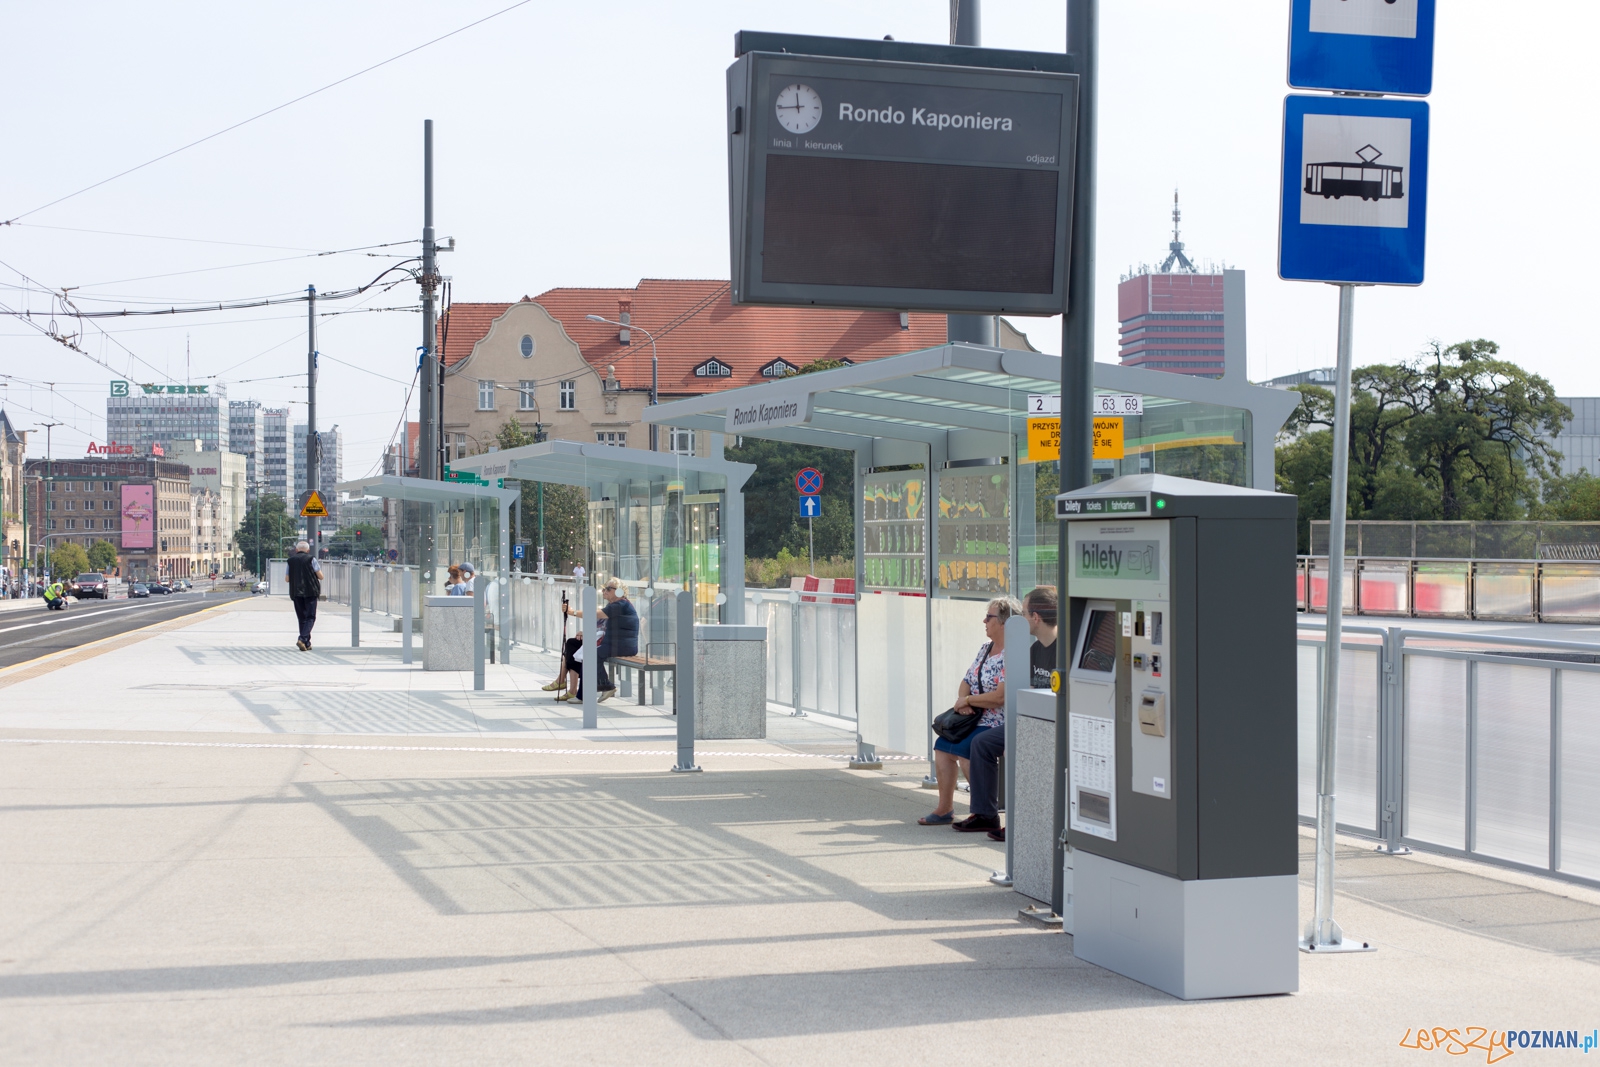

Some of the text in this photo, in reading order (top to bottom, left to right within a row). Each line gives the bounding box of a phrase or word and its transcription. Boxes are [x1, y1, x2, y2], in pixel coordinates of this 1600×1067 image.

[839, 103, 1013, 131] Rondo Kaponiera
[773, 138, 843, 151] linia kierunek
[1026, 154, 1055, 165] odjazd
[1036, 398, 1138, 411] 2 63 69
[733, 400, 798, 426] Rondo Kaponiera
[87, 441, 133, 454] Amica
[1101, 439, 1112, 448] SIĘ
[1065, 500, 1136, 513] bilety tickets fahrkarten
[1082, 543, 1122, 576] bilety
